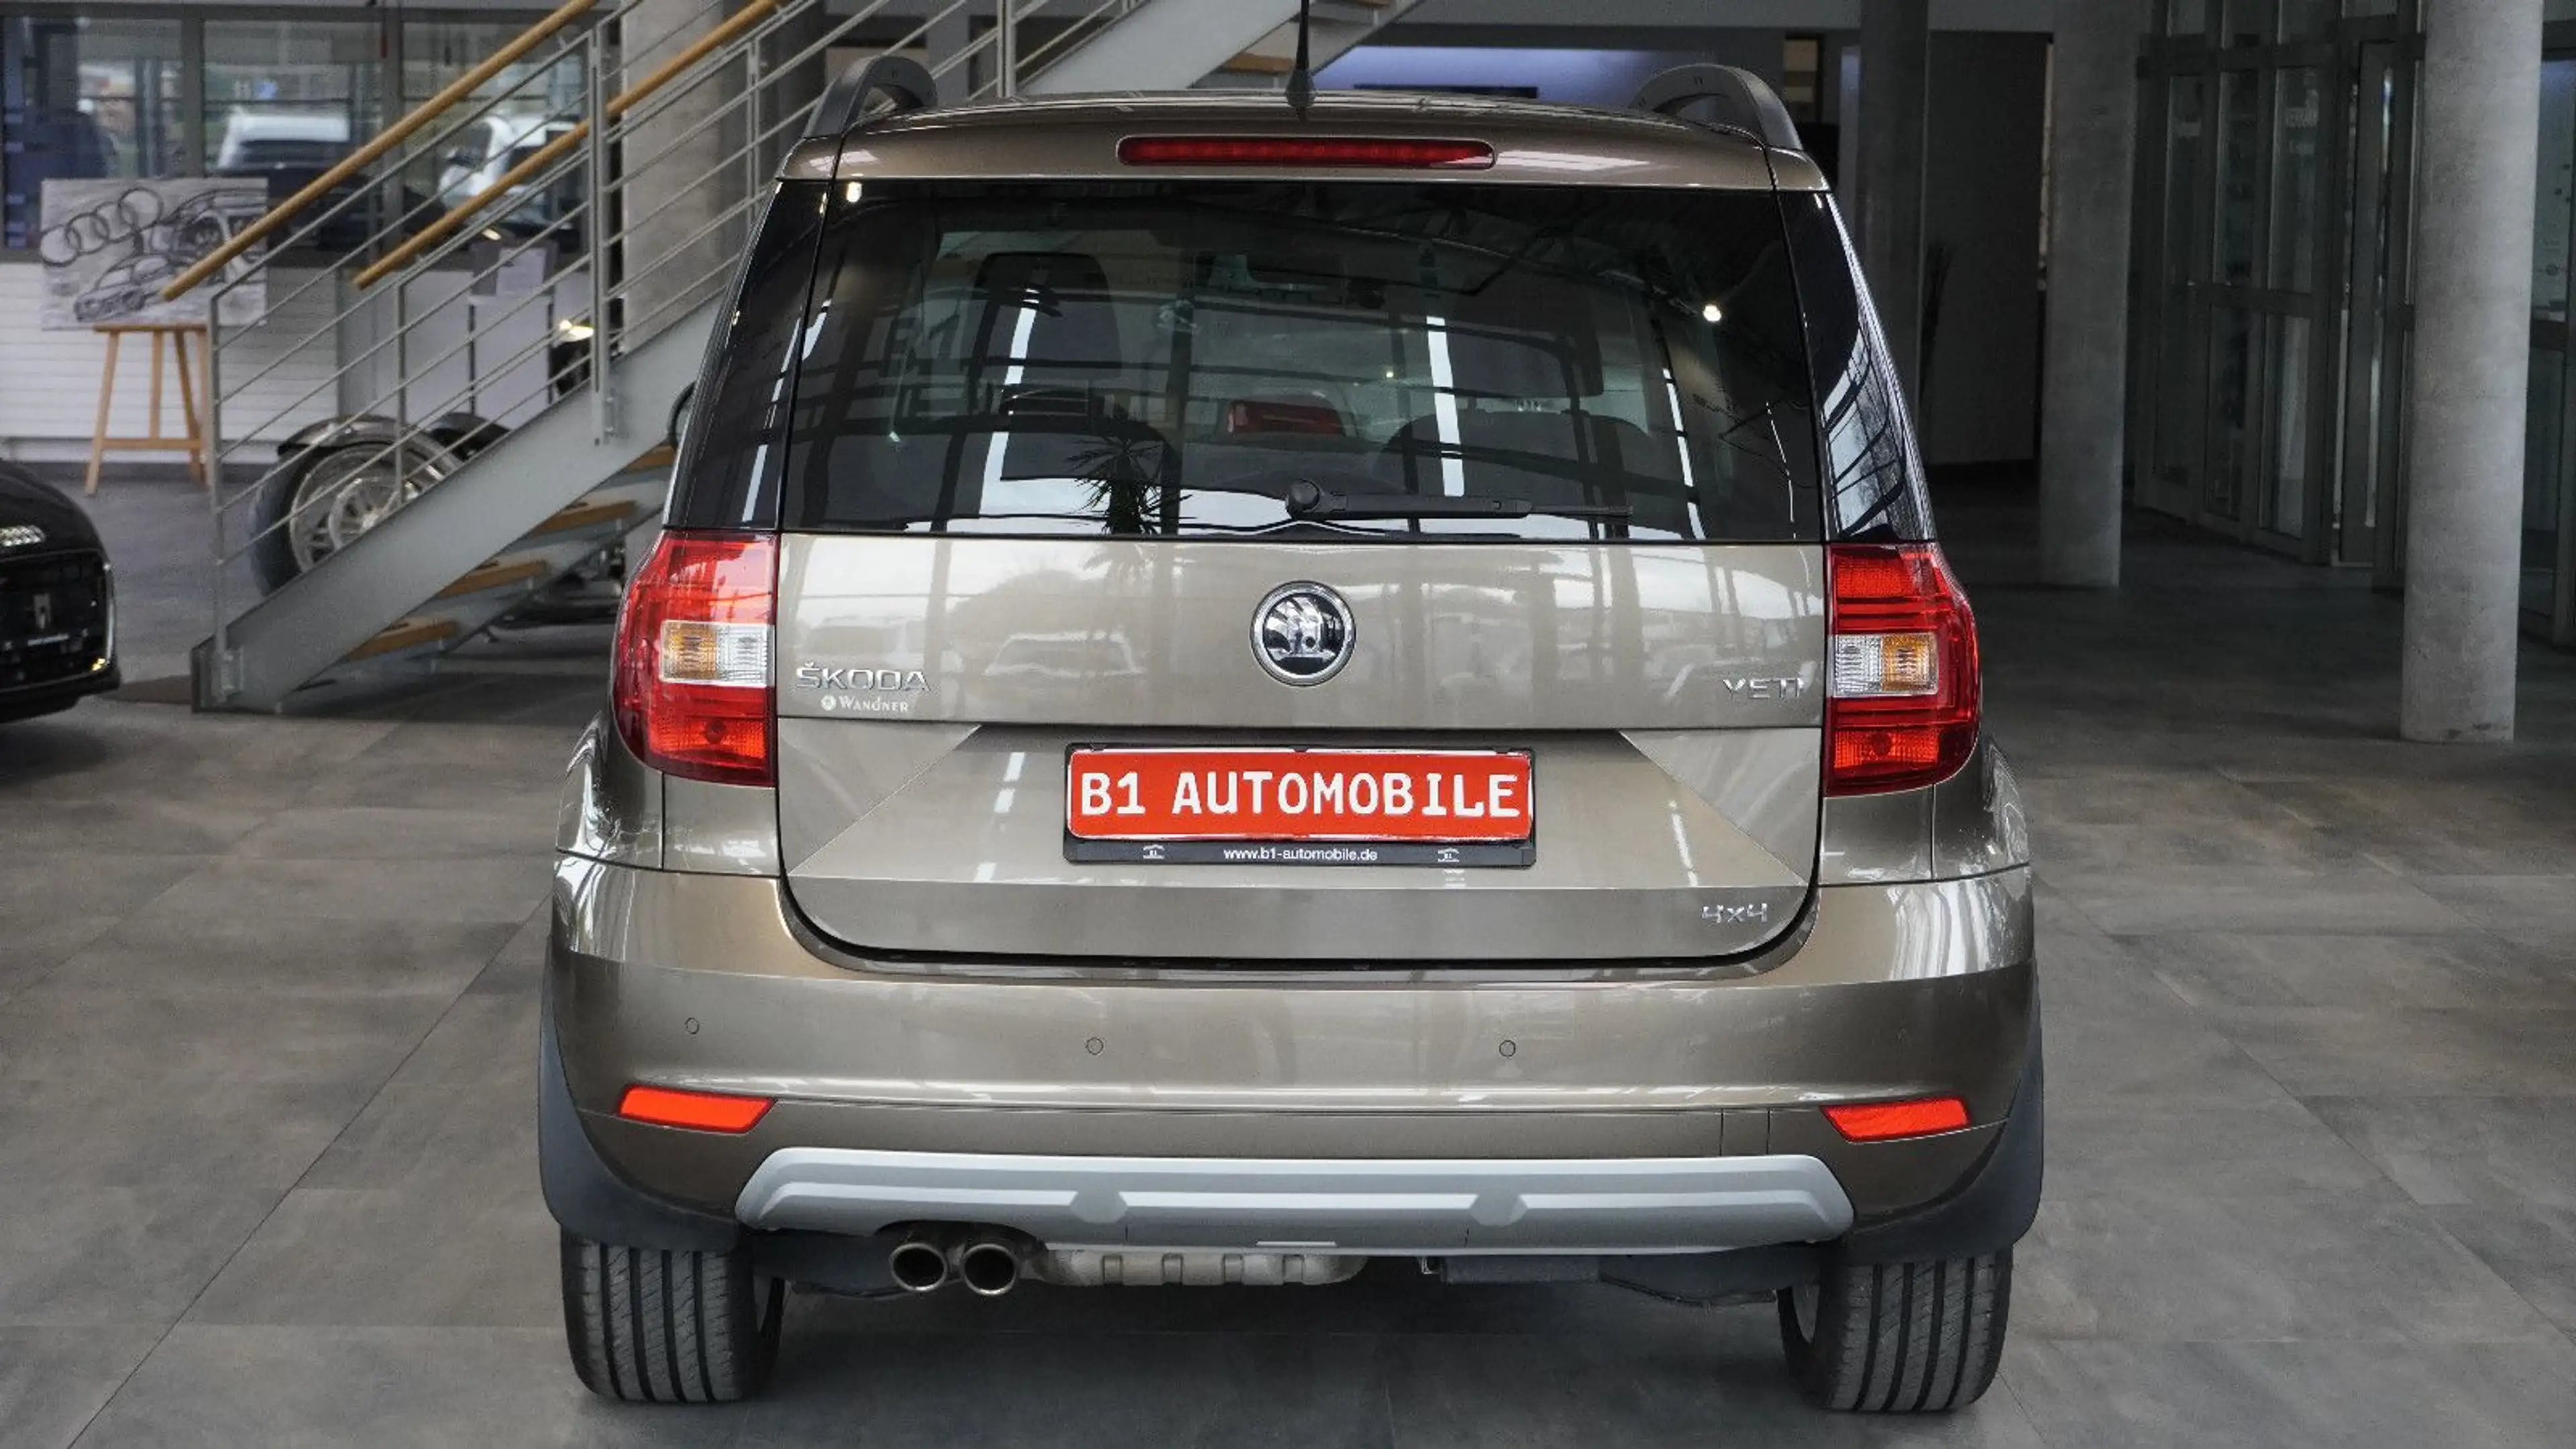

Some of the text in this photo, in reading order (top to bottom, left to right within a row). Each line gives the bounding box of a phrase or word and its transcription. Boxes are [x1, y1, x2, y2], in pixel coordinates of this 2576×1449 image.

[796, 662, 930, 692] ŠKODA
[1722, 677, 1805, 700] YETI
[1081, 771, 1521, 818] B1 AUTOMOBILE
[1223, 847, 1378, 861] www.b1-automobile.de
[1701, 903, 1768, 923] 4x4
